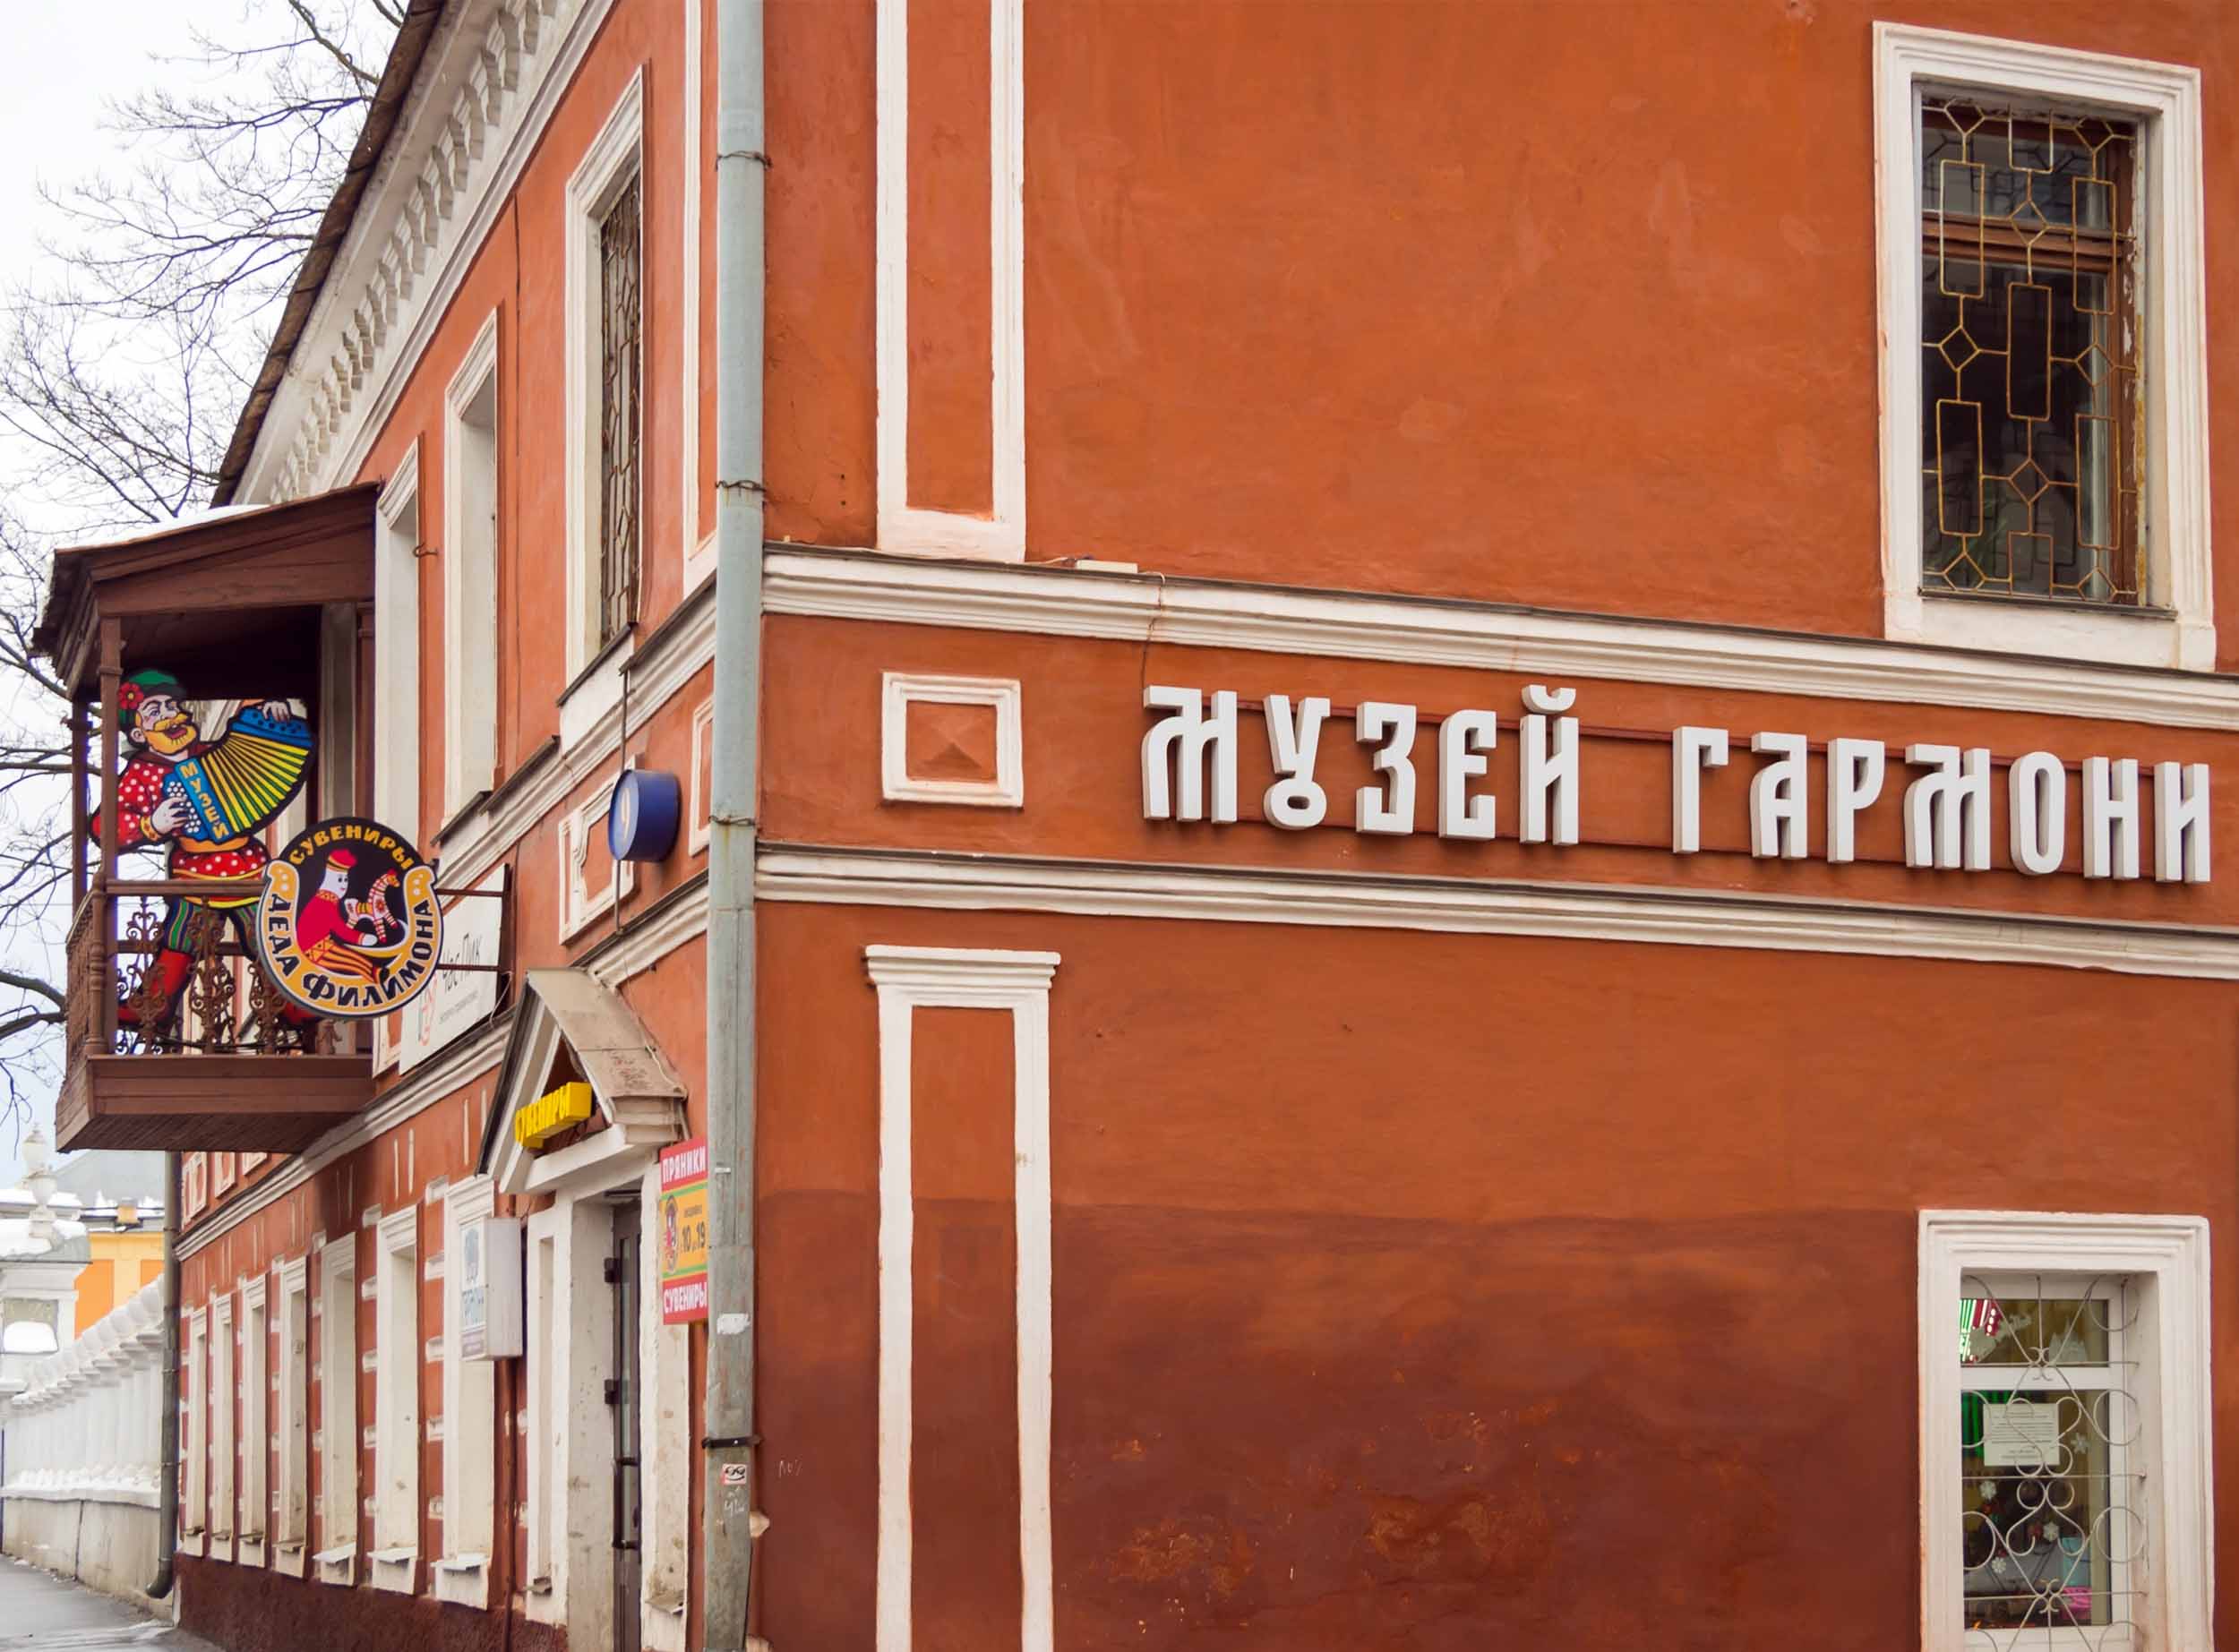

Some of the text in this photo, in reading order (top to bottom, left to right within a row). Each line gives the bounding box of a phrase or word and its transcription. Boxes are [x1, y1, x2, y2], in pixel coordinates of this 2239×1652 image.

[180, 761, 229, 839] МУЗЕЙ
[1142, 684, 2211, 883] МУЗЕЙ ГАРМОНИ
[289, 825, 415, 869] СУВЕНИРЫ
[268, 894, 433, 1007] ДЕДА ФИЛИМОНА
[663, 1146, 706, 1183] ПРЯНИКИ
[663, 1282, 707, 1314] СУВЕНИРЫ
